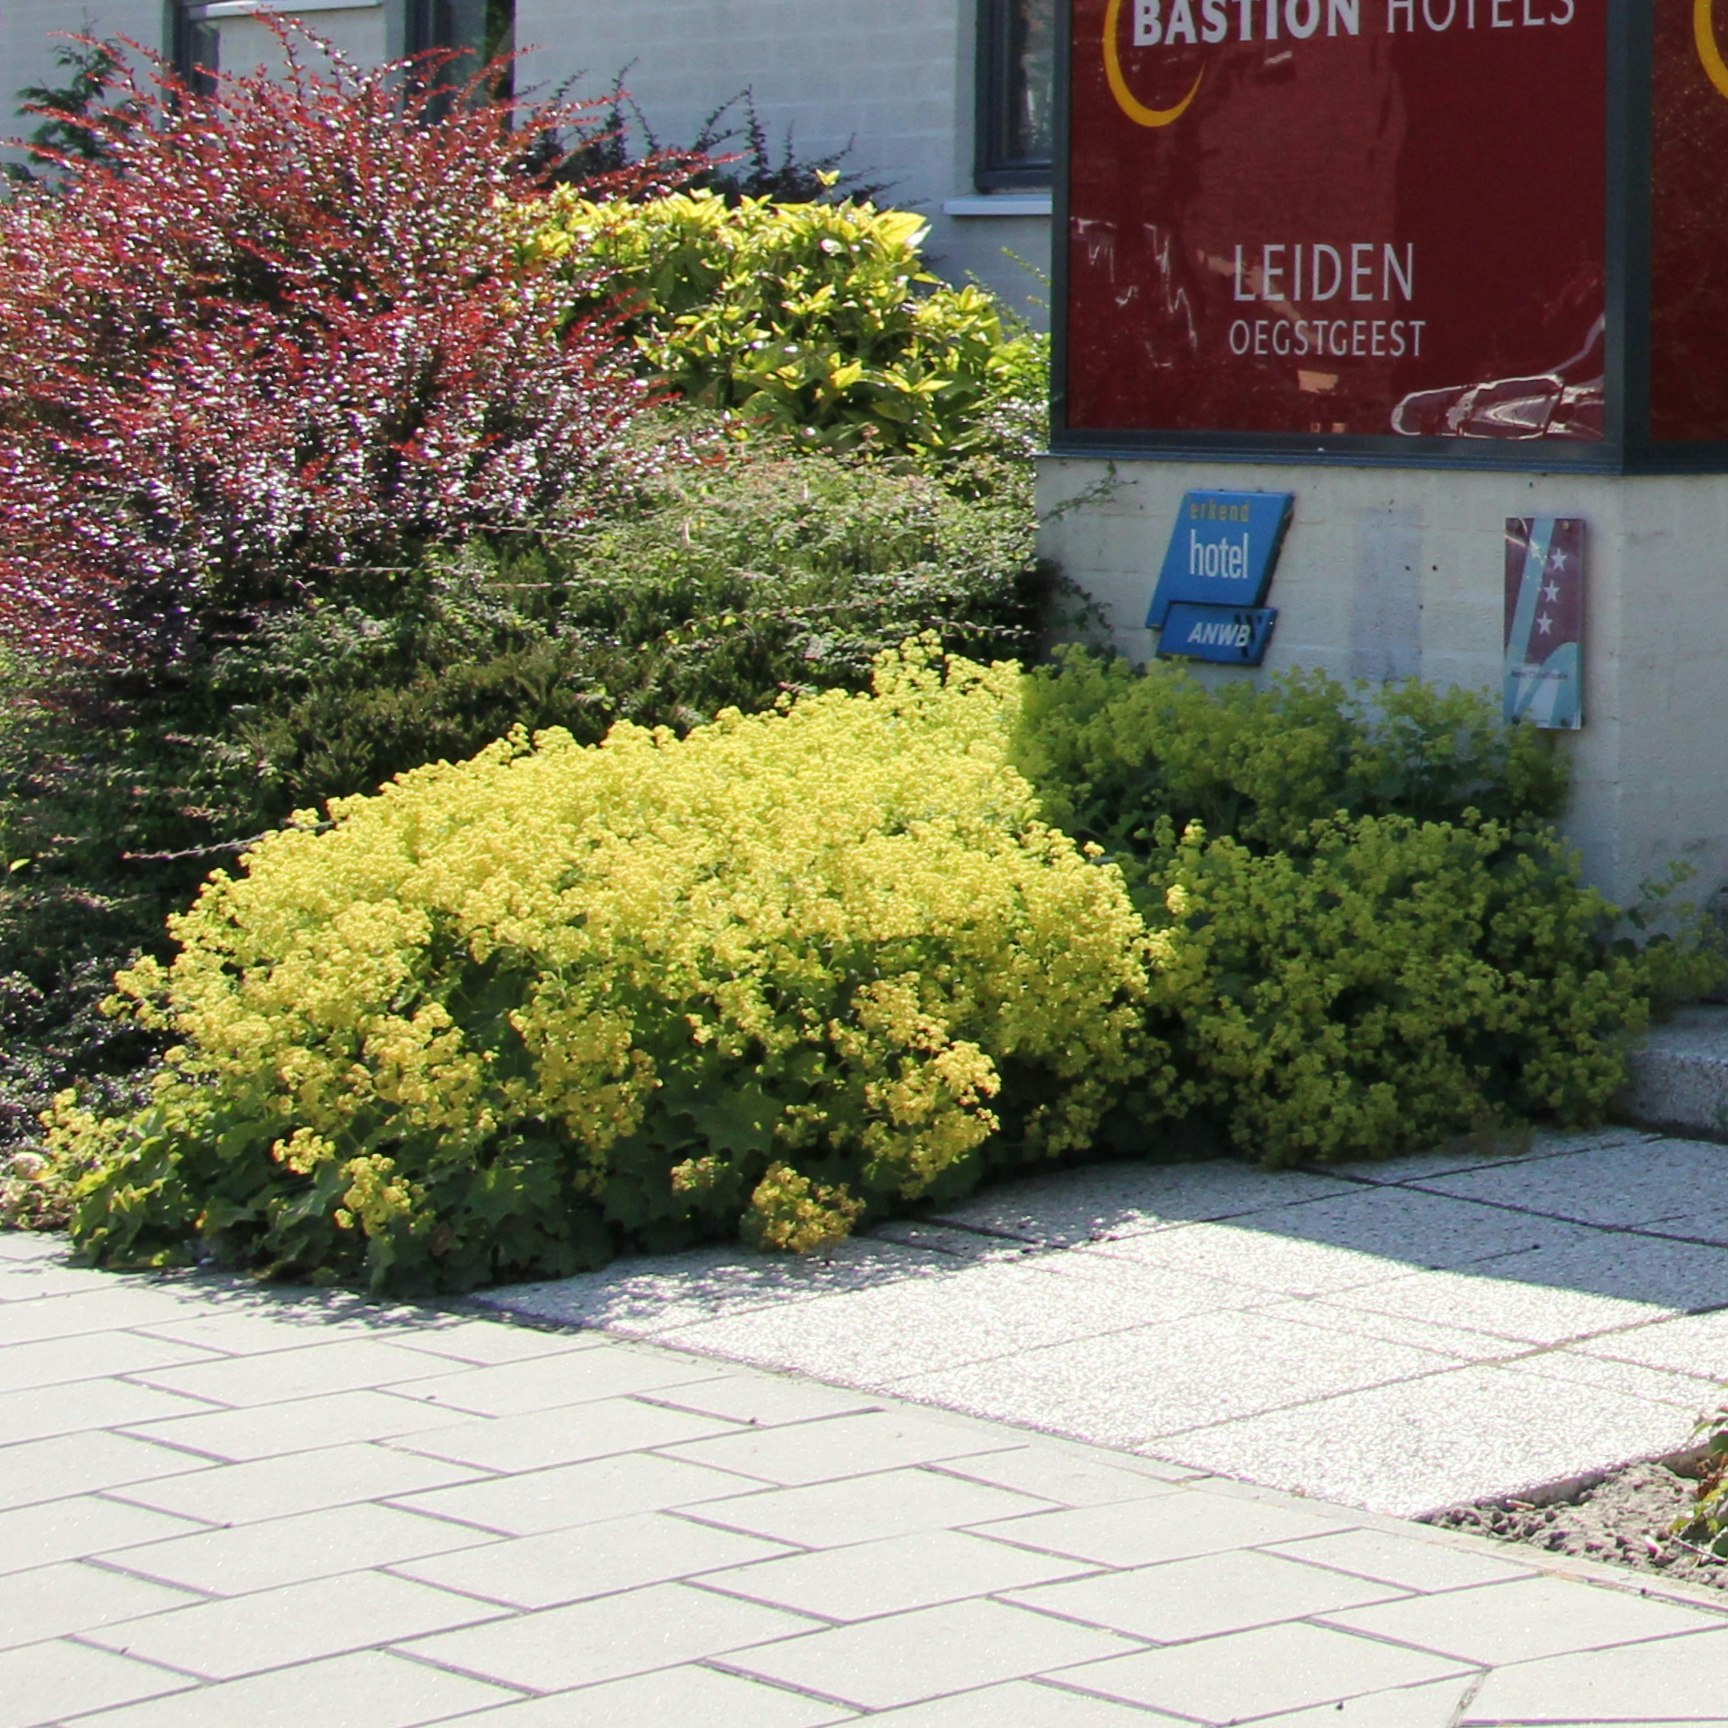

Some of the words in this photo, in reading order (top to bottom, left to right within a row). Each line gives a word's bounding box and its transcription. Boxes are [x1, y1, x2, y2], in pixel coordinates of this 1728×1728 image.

[1233, 242, 1414, 302] LEIDEN
[1228, 319, 1427, 358] OEGSTGEEST
[1190, 500, 1250, 523] erkend
[1189, 527, 1249, 580] hotel
[1186, 621, 1252, 648] ANWB
